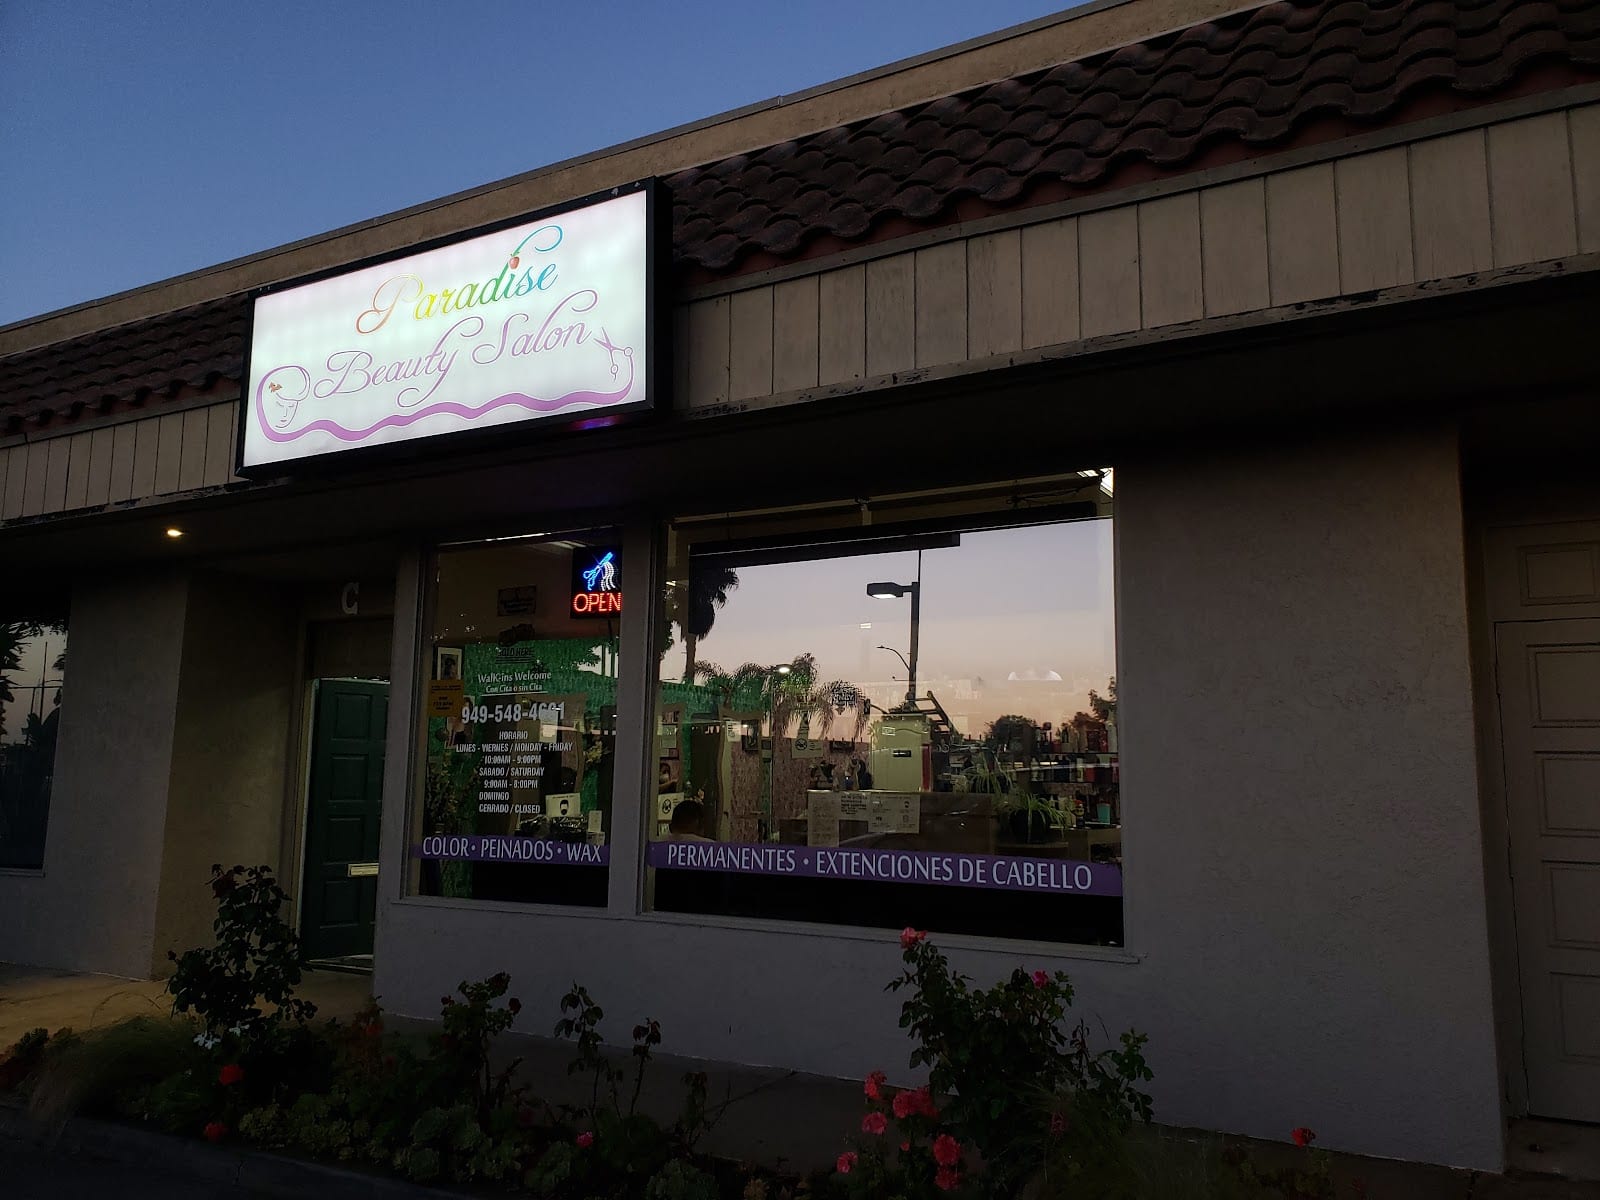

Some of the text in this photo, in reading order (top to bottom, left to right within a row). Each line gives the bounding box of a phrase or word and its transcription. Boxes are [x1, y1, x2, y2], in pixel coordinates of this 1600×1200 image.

[355, 225, 563, 334] Paradise
[313, 289, 598, 407] Beauty Salon
[341, 582, 360, 615] C
[572, 592, 622, 612] OPEN
[514, 670, 552, 681] Welcome
[499, 684, 513, 693] Cita
[529, 683, 543, 691] Cita
[499, 730, 528, 740] HORARIO
[456, 743, 476, 753] LUNES
[481, 743, 509, 753] VIERNES
[514, 743, 542, 752] MONDAY
[548, 742, 573, 752] FRIDAY
[484, 755, 511, 764] 10:00AM
[479, 767, 505, 777] SABADO
[510, 767, 545, 777] SATURDAY
[478, 791, 510, 801] DOMINGO
[478, 803, 510, 814] CERRADO
[514, 804, 541, 814] CLOSED
[422, 836, 470, 857] COLOR
[480, 838, 554, 861] PEINADOS
[566, 841, 603, 863] WAX
[667, 844, 797, 873] PERMANENTES
[816, 850, 954, 882] EXTENCIONES
[959, 858, 987, 884] DE
[992, 860, 1093, 890] CABELLO
